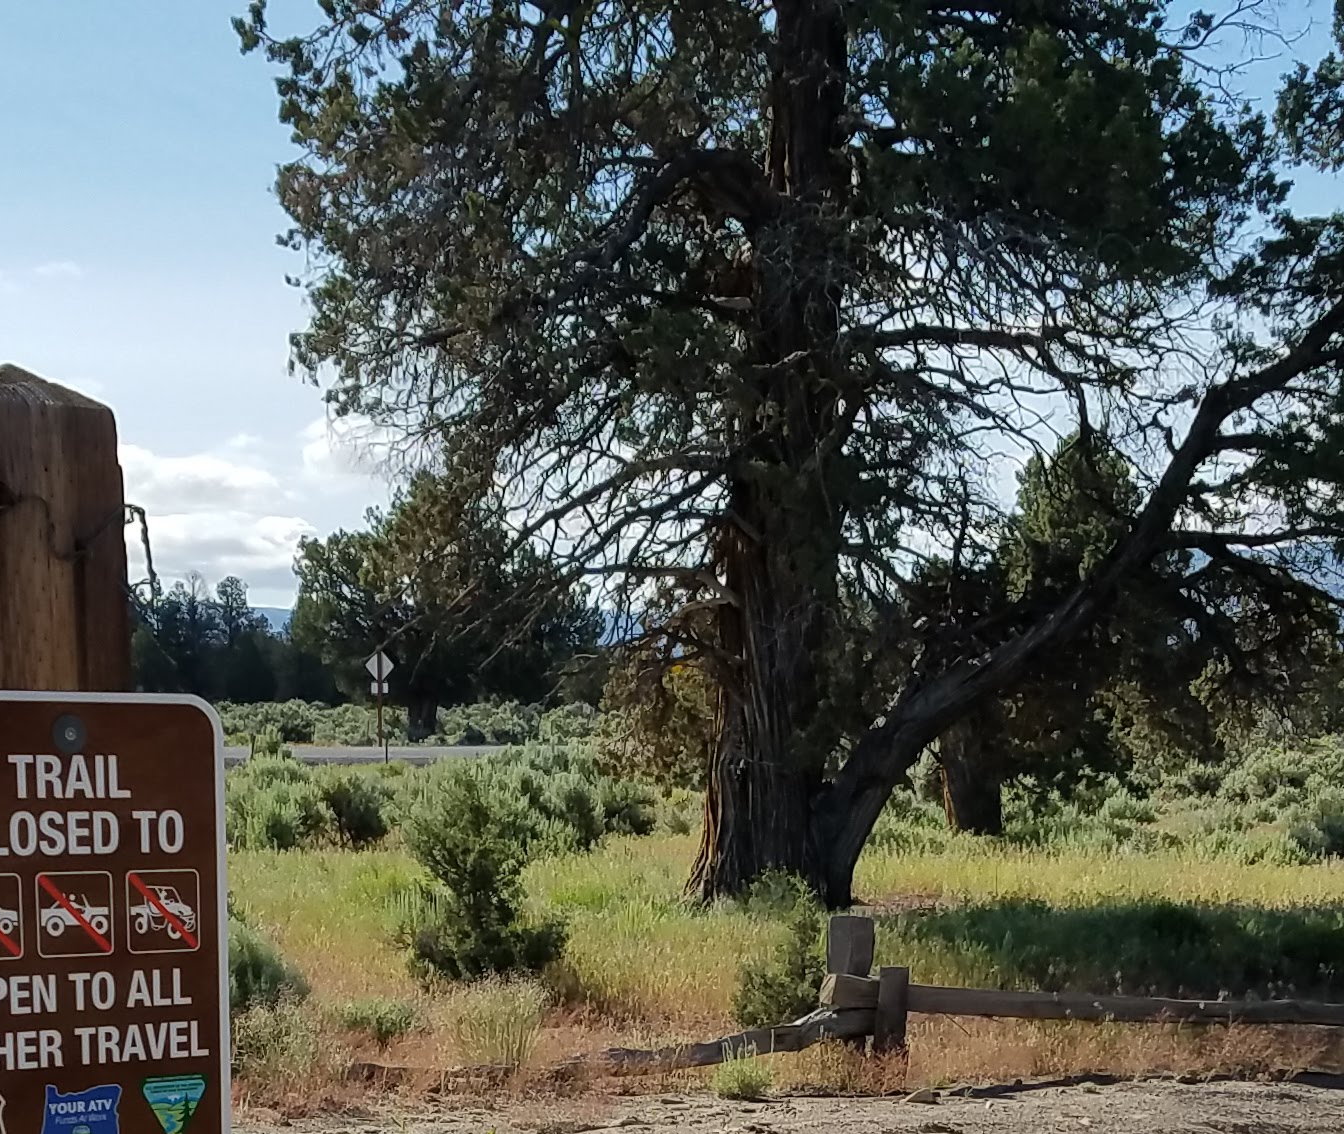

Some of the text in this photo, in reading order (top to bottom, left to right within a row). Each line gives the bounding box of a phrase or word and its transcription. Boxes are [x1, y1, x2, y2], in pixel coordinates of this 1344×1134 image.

[7, 754, 132, 799] TRAIL
[131, 810, 184, 854] TO
[68, 971, 116, 1011] TO
[126, 968, 192, 1008] ALL
[74, 1020, 210, 1065] TRAVEL
[48, 1098, 113, 1115] YOUR ATV
